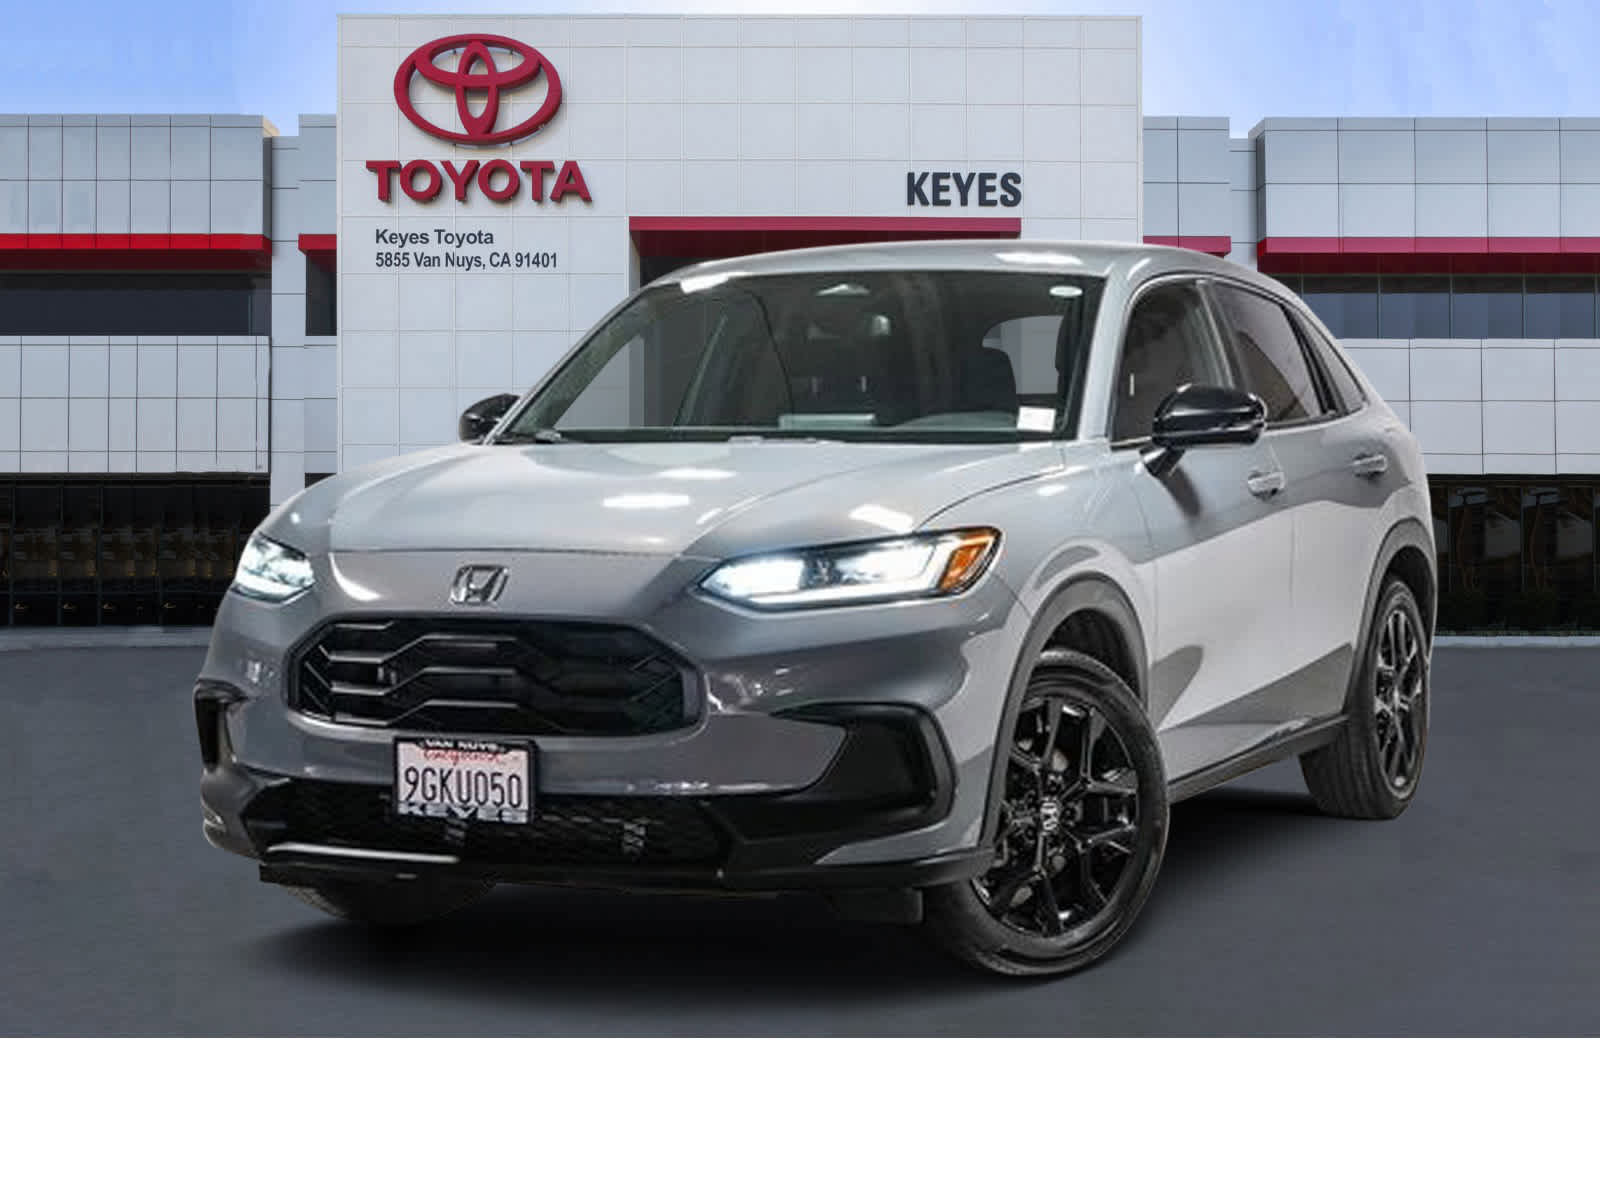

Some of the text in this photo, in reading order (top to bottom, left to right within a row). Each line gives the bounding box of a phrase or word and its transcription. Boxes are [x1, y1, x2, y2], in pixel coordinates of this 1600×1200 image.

[365, 159, 593, 203] TOYOTA
[907, 171, 1022, 208] KEYES
[375, 229, 494, 248] Keyes Toyota
[375, 251, 557, 271] 5855 Van Nuys, CA 91401
[404, 767, 522, 808] 9GKU050
